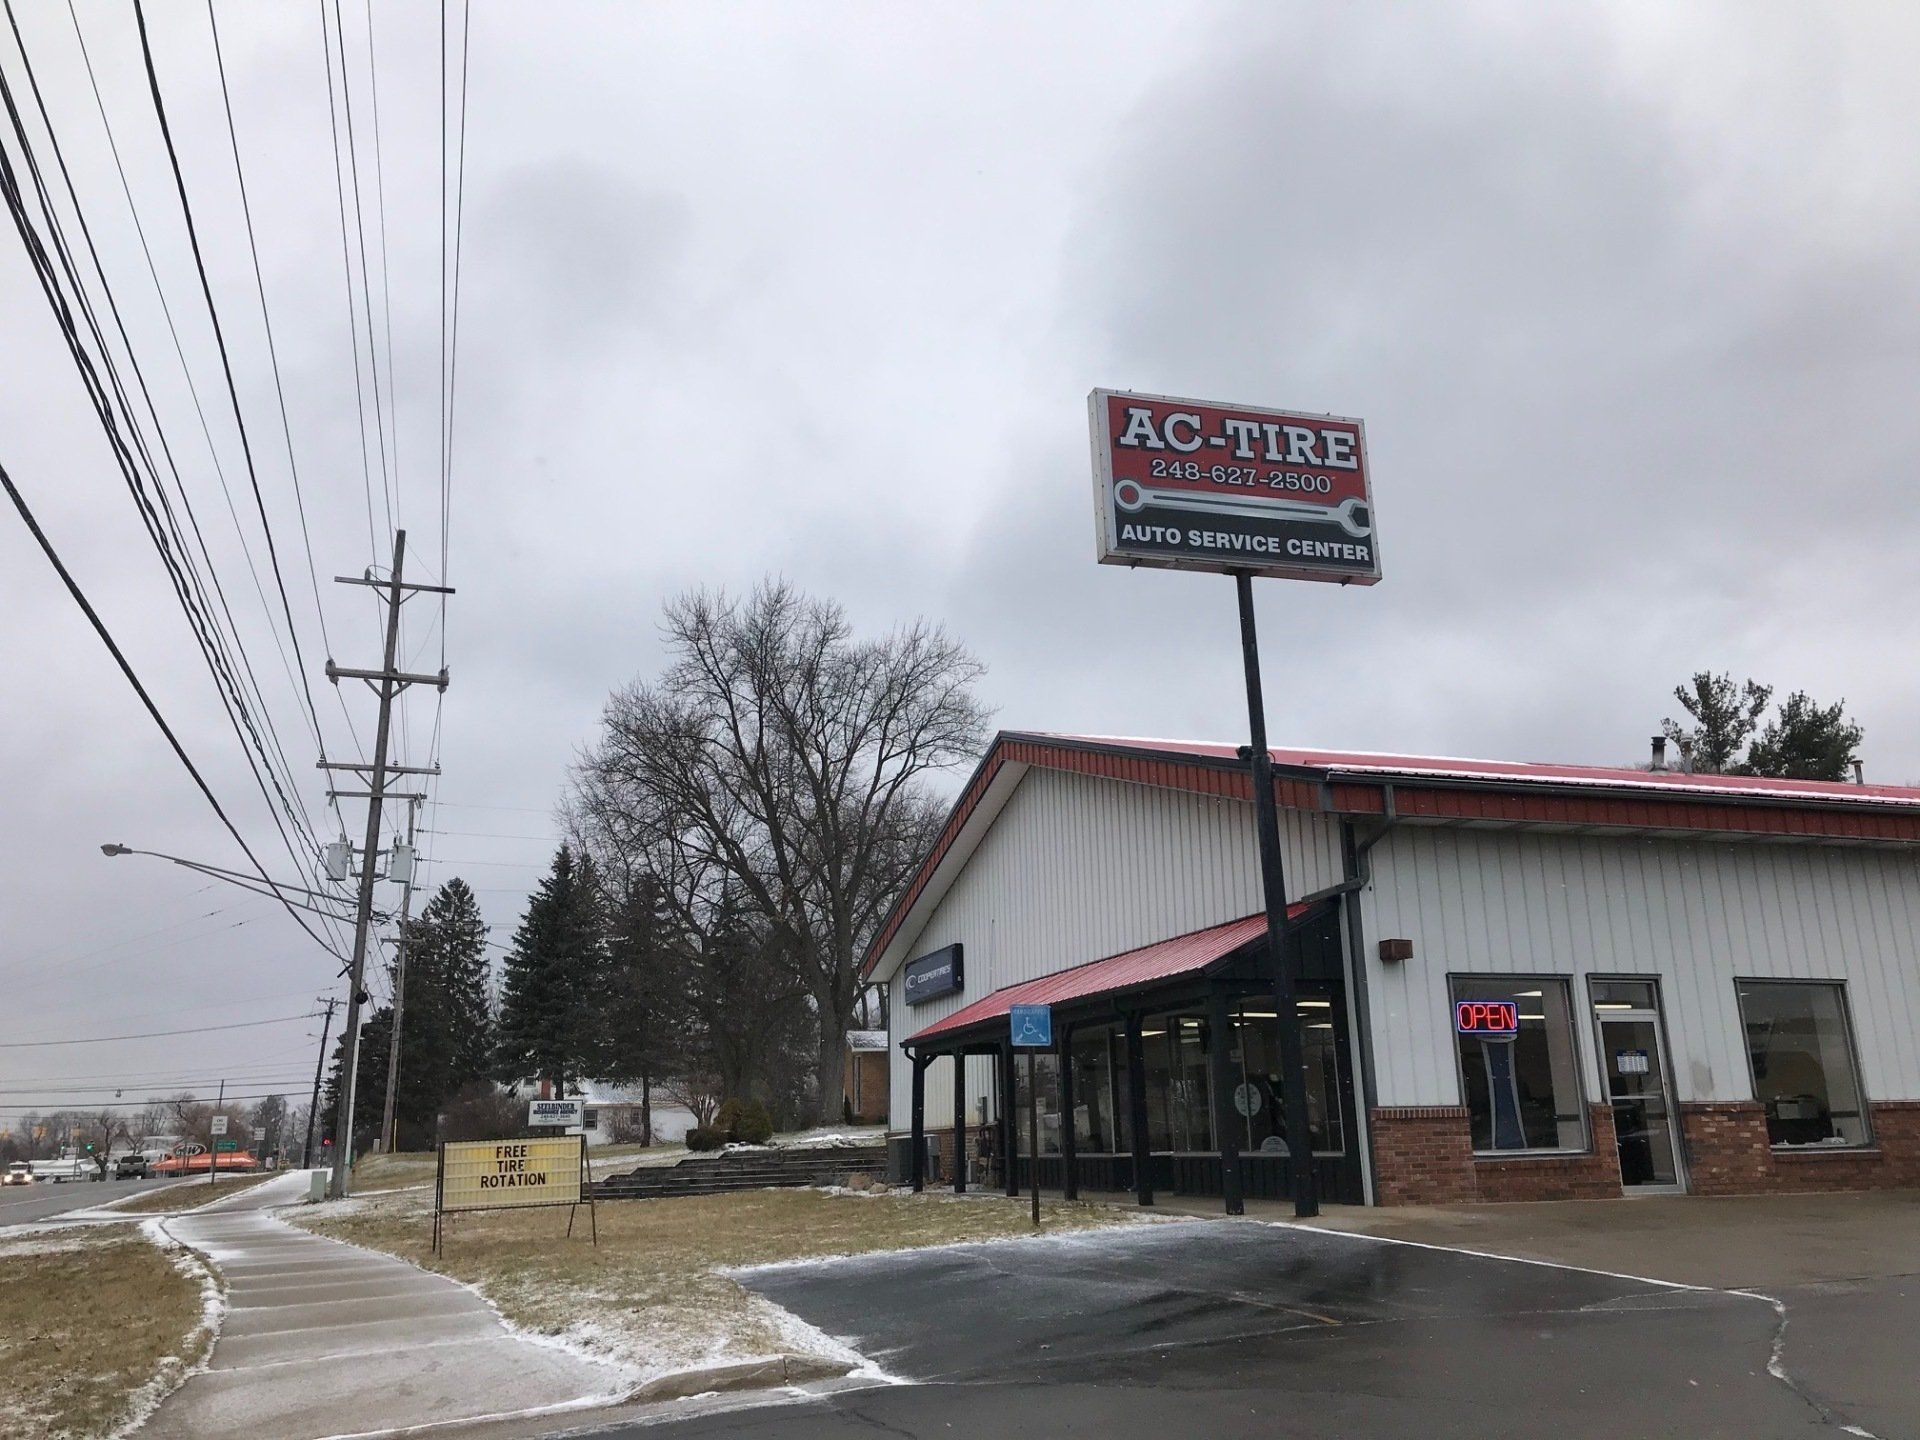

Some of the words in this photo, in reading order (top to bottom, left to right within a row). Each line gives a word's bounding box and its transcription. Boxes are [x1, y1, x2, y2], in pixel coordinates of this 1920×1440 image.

[1120, 407, 1358, 470] AC-TIRE
[1151, 458, 1331, 494] 248-627-2500
[1121, 524, 1182, 545] AUTO
[1188, 530, 1281, 554] SERVICE
[1286, 538, 1370, 562] CENTER
[1459, 1004, 1515, 1030] OPEN
[495, 1145, 528, 1159] FREE
[496, 1159, 525, 1173] TIRE
[480, 1172, 546, 1189] ROTATION
